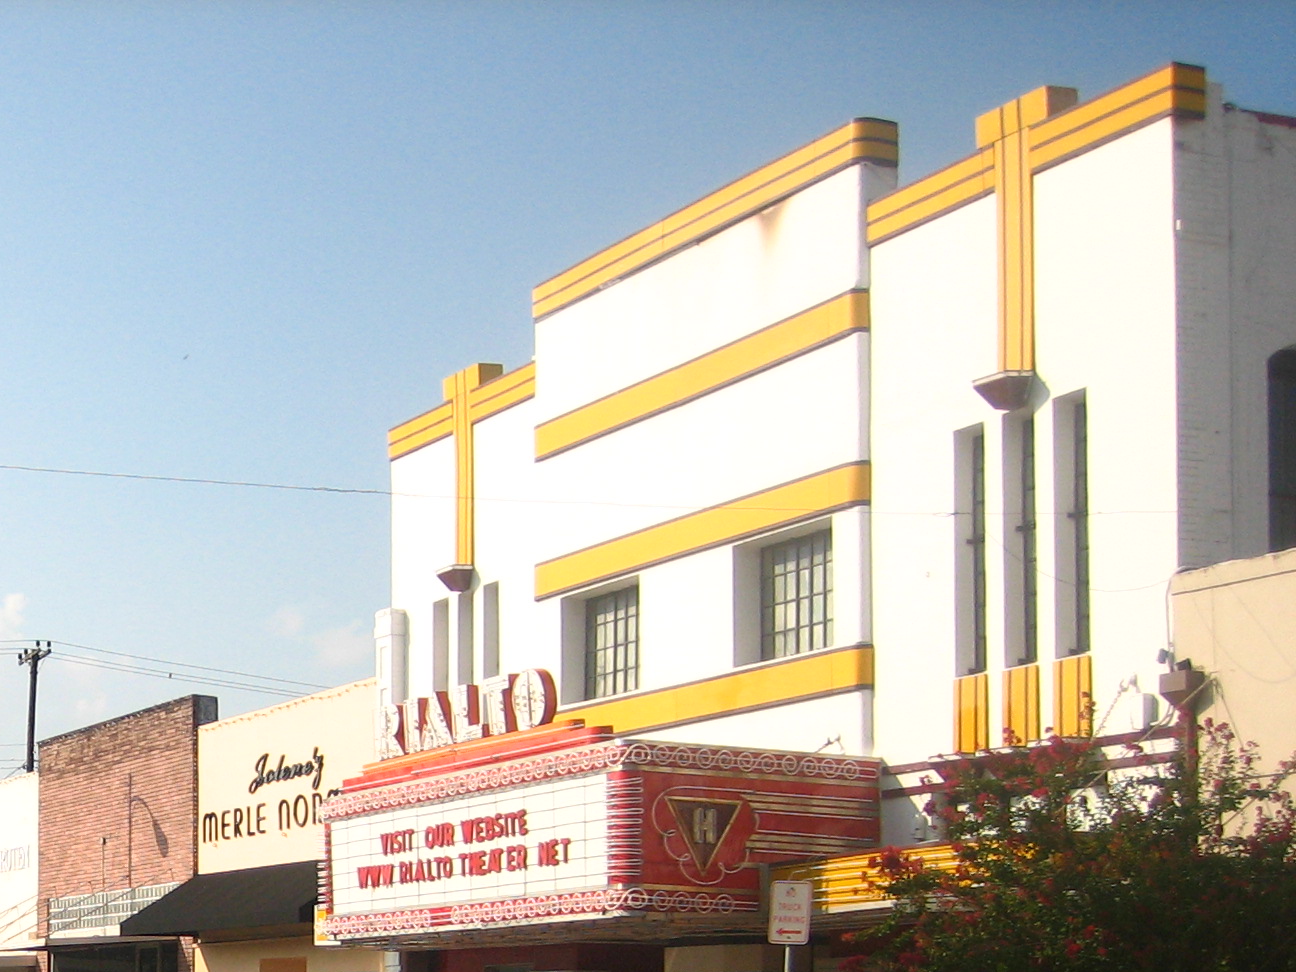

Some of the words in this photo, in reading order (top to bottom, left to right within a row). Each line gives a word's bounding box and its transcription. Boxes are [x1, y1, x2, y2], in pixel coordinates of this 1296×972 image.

[380, 668, 558, 762] RIALTO
[202, 803, 267, 843] MERLE
[278, 789, 343, 832] NOR
[380, 828, 415, 857] VISIT
[425, 822, 455, 850] OUR
[460, 808, 529, 845] WEBSITE
[693, 807, 717, 844] H
[357, 863, 394, 889] WWW
[399, 855, 454, 885] RIALTO
[458, 844, 528, 877] THEATER
[537, 838, 571, 867] NET
[773, 915, 806, 924] PARKING
